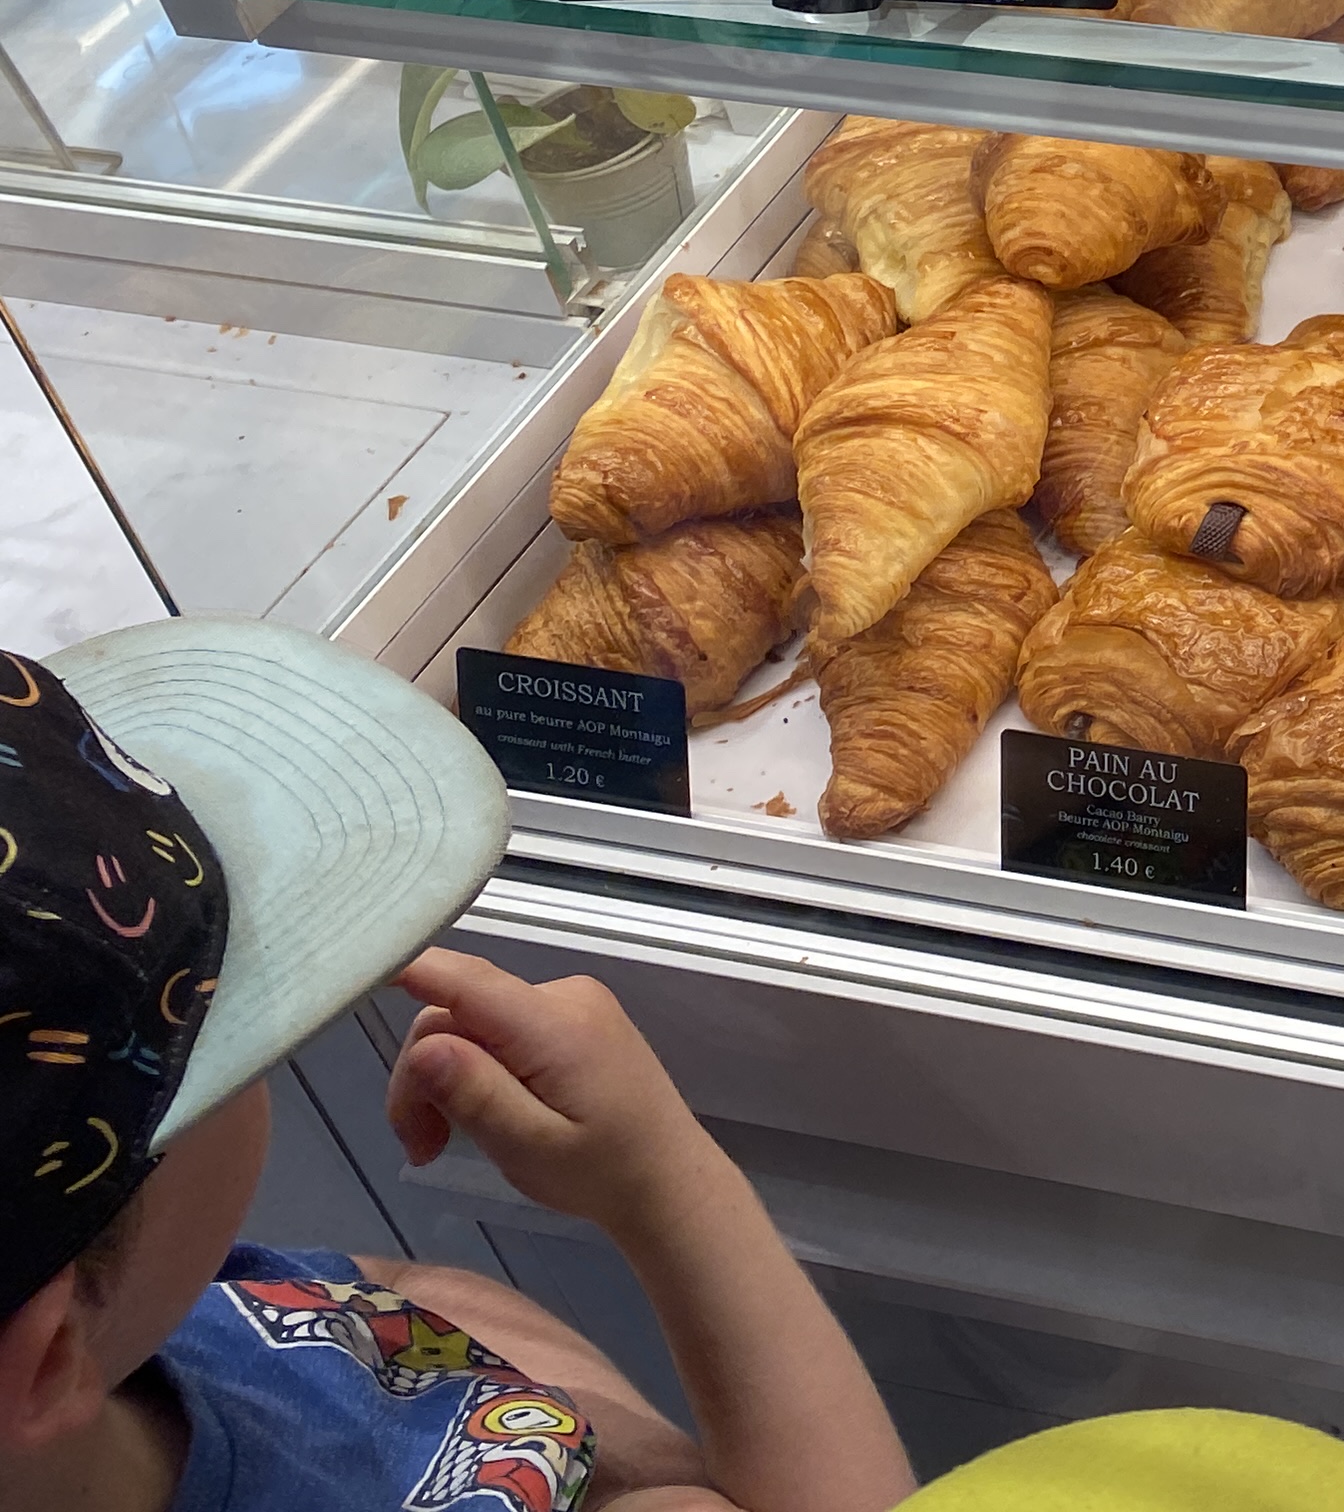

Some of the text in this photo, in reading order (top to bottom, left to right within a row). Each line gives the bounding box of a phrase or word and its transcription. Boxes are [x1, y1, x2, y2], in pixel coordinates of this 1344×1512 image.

[499, 672, 644, 713] CROISSANT
[475, 706, 671, 746] au pure beurre AOP Montaigu
[546, 763, 589, 785] 1.20
[1068, 747, 1178, 783] PAIN AU
[1047, 770, 1199, 813] CHOCOLAT
[1058, 811, 1189, 843] Beurre AOP Montaigu
[1087, 804, 1160, 827] Cacao Barry
[1145, 866, 1155, 879] €
